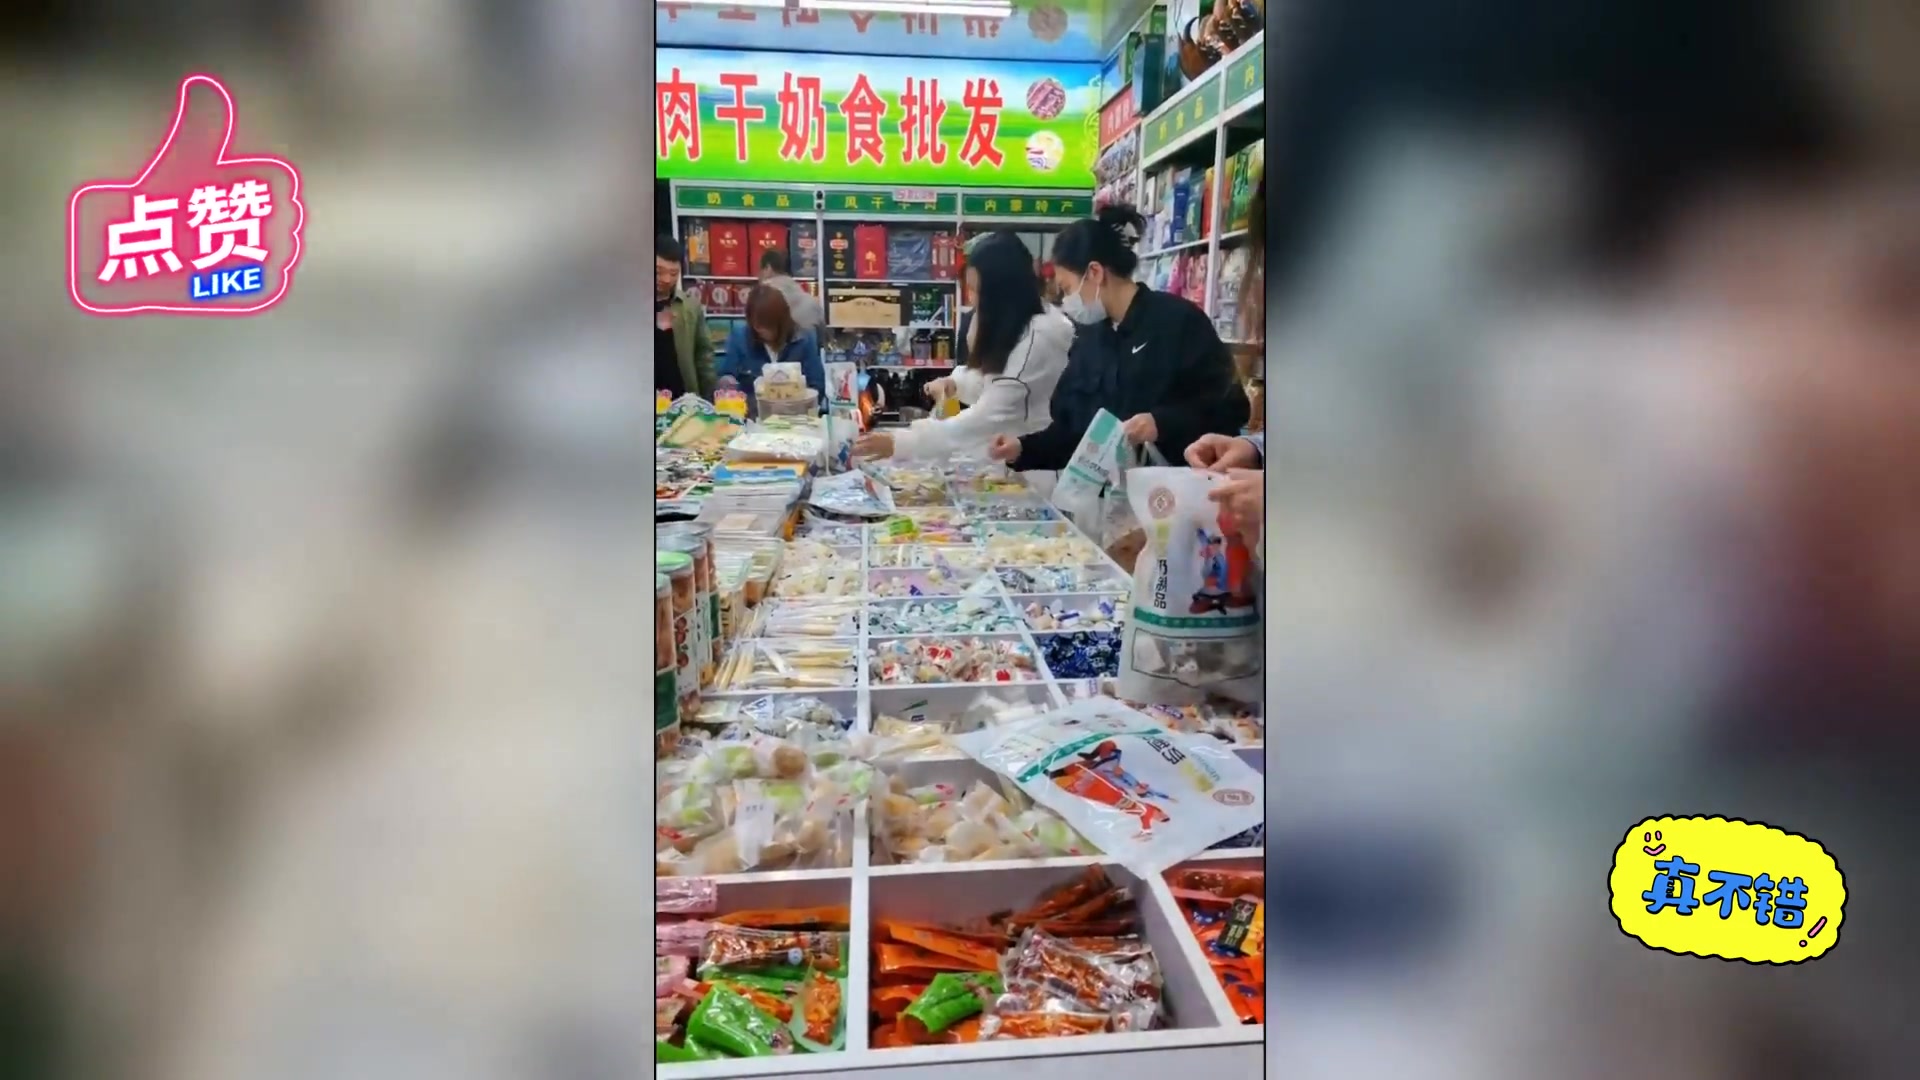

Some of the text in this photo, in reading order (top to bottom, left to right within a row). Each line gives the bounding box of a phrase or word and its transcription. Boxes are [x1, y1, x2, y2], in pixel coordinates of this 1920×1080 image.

[656, 67, 1004, 167] 肉干奶食批发
[707, 192, 790, 208] 奶食品
[984, 199, 1074, 213] 内蒙特产
[1142, 736, 1186, 765] 奶制
